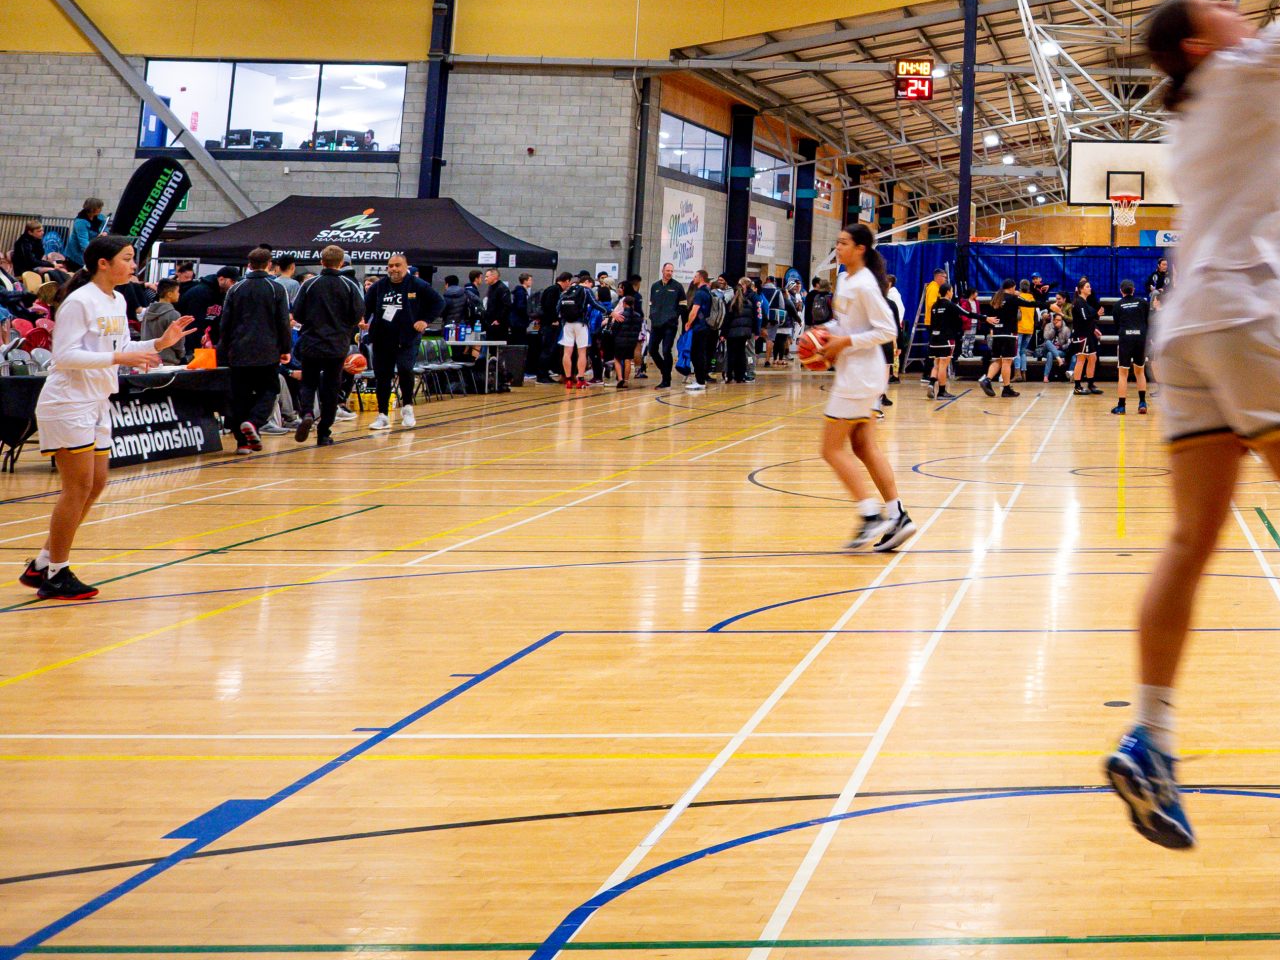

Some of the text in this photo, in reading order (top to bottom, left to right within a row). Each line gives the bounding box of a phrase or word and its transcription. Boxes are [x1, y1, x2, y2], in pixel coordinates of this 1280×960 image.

[898, 61, 931, 75] 04:48
[907, 79, 929, 97] 24
[128, 167, 174, 237] ASKETBALL
[316, 230, 380, 239] SPORT
[110, 396, 178, 429] National
[109, 420, 205, 460] hampionship
